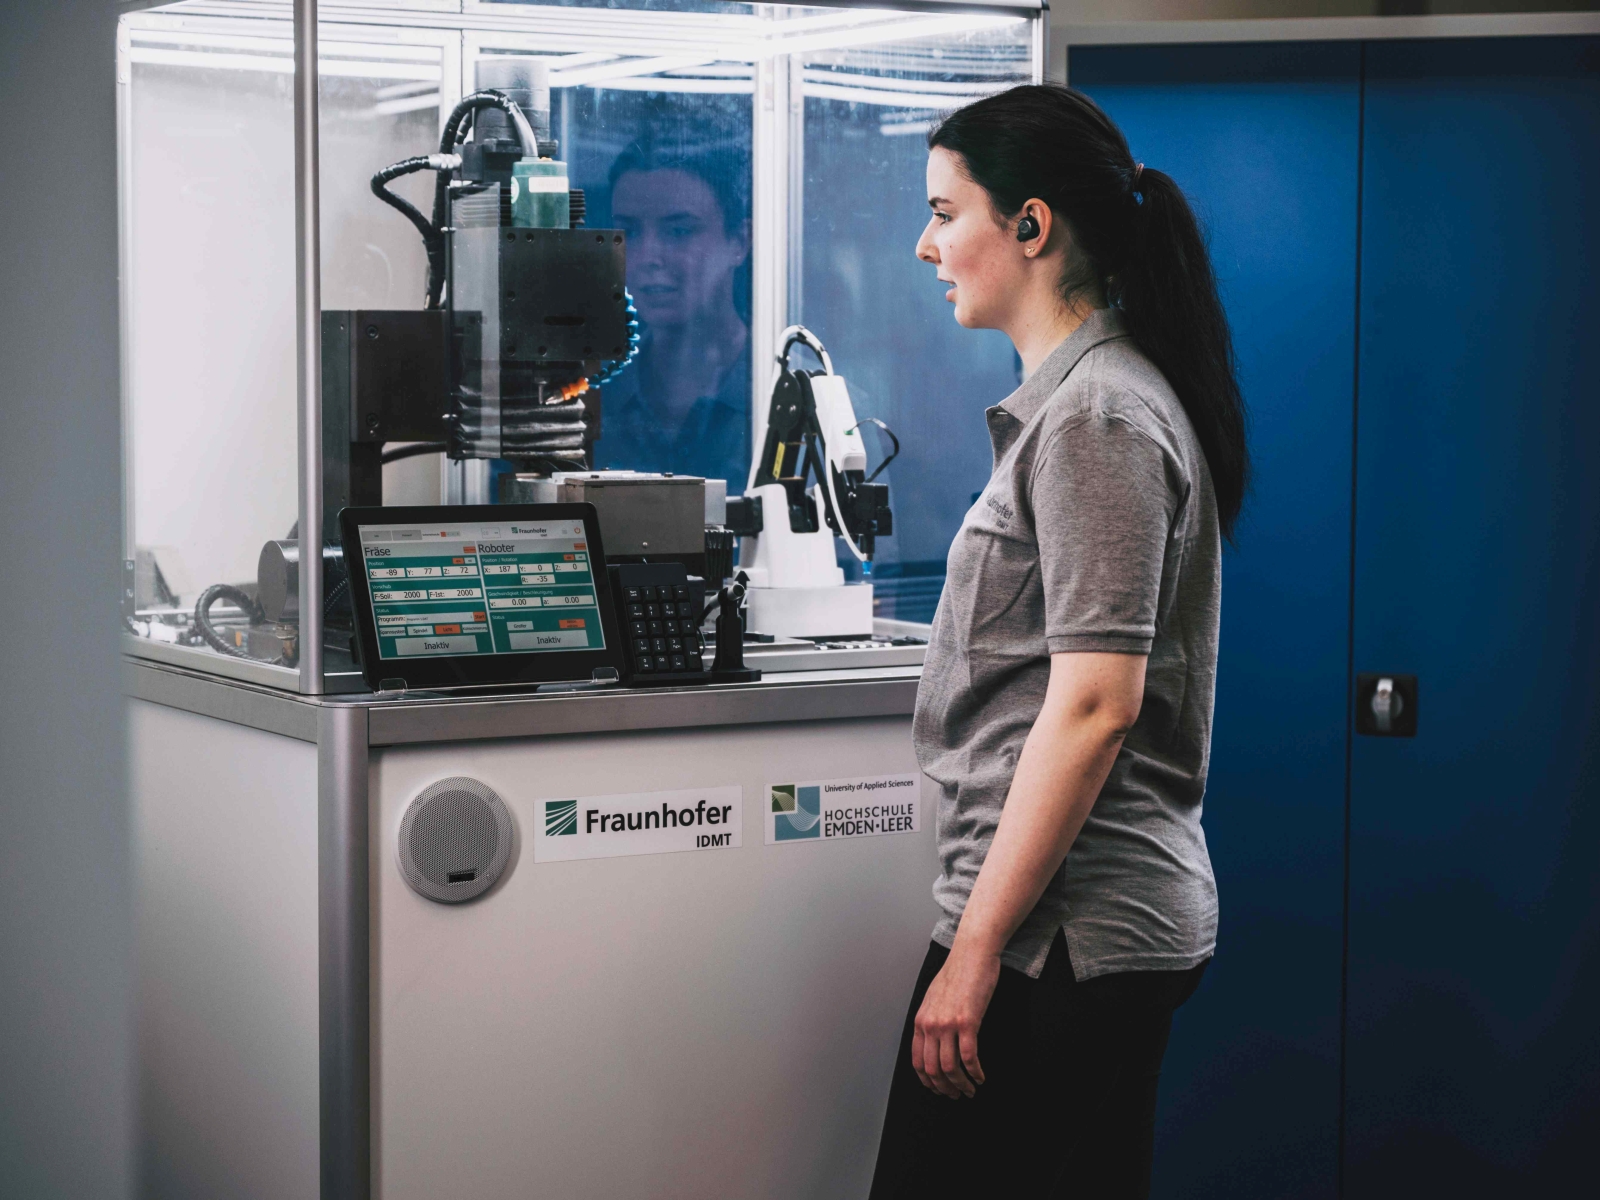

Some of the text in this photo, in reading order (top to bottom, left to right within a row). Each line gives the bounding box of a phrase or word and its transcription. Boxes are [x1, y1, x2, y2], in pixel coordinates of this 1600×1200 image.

[364, 547, 391, 556] Fräse
[478, 544, 515, 553] Roboter
[537, 636, 561, 644] Inaktiv
[424, 642, 450, 650] Inaktiv
[824, 783, 855, 793] University
[864, 780, 886, 790] Applied
[586, 800, 732, 833] Fraunhofer
[825, 804, 913, 821] HOCHSCHULE
[696, 833, 732, 847] IDMT
